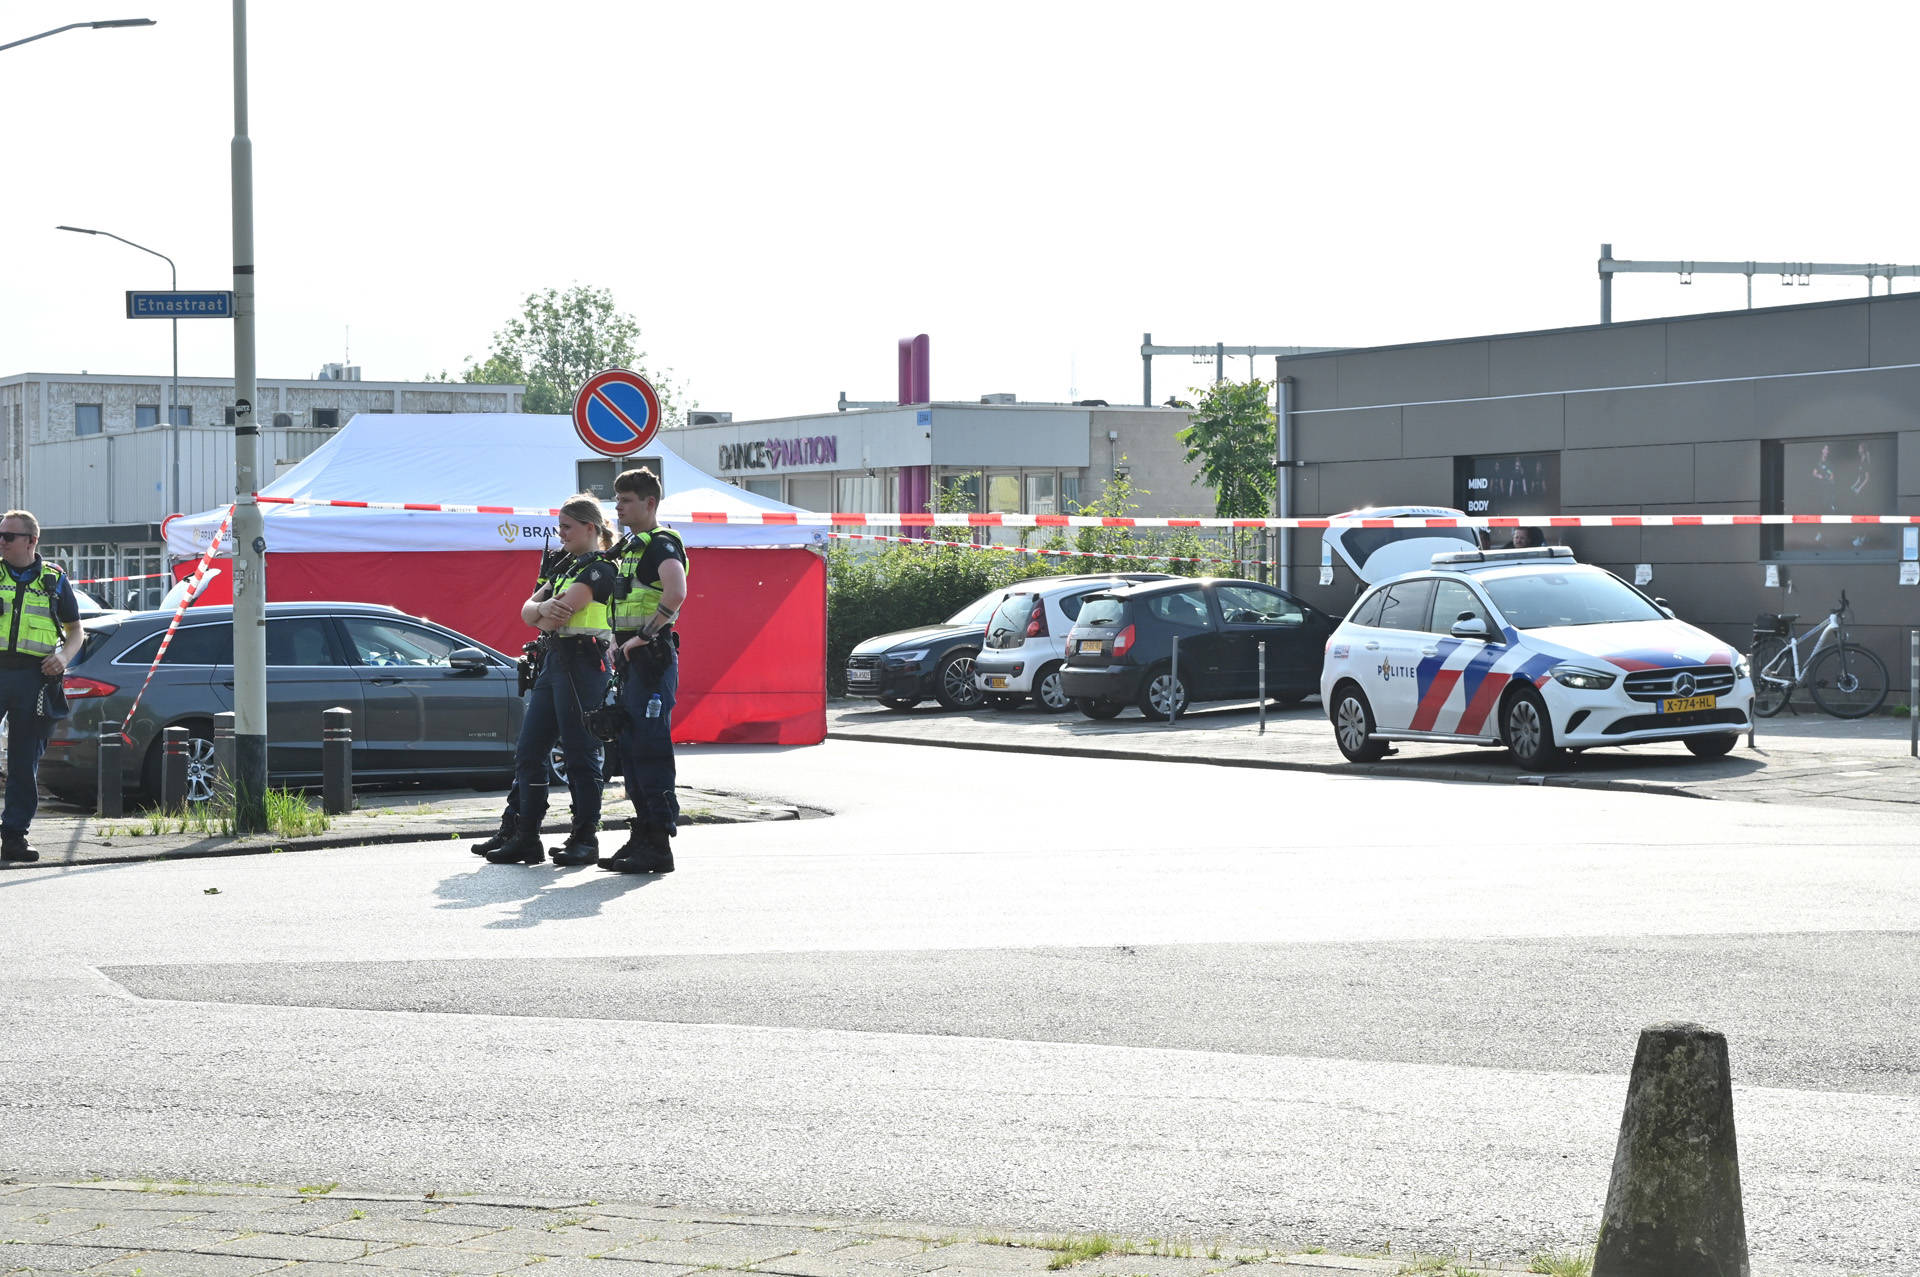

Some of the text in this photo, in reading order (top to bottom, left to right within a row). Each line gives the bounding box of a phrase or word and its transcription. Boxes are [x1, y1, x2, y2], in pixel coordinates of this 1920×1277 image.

[137, 298, 223, 312] Etnastraat
[718, 435, 838, 471] DANCE NATION
[1468, 478, 1488, 489] MIND
[1468, 500, 1489, 511] BODY
[522, 526, 560, 538] BRAN
[1378, 664, 1415, 681] POLITIE
[1667, 697, 1712, 712] X-774-HL
